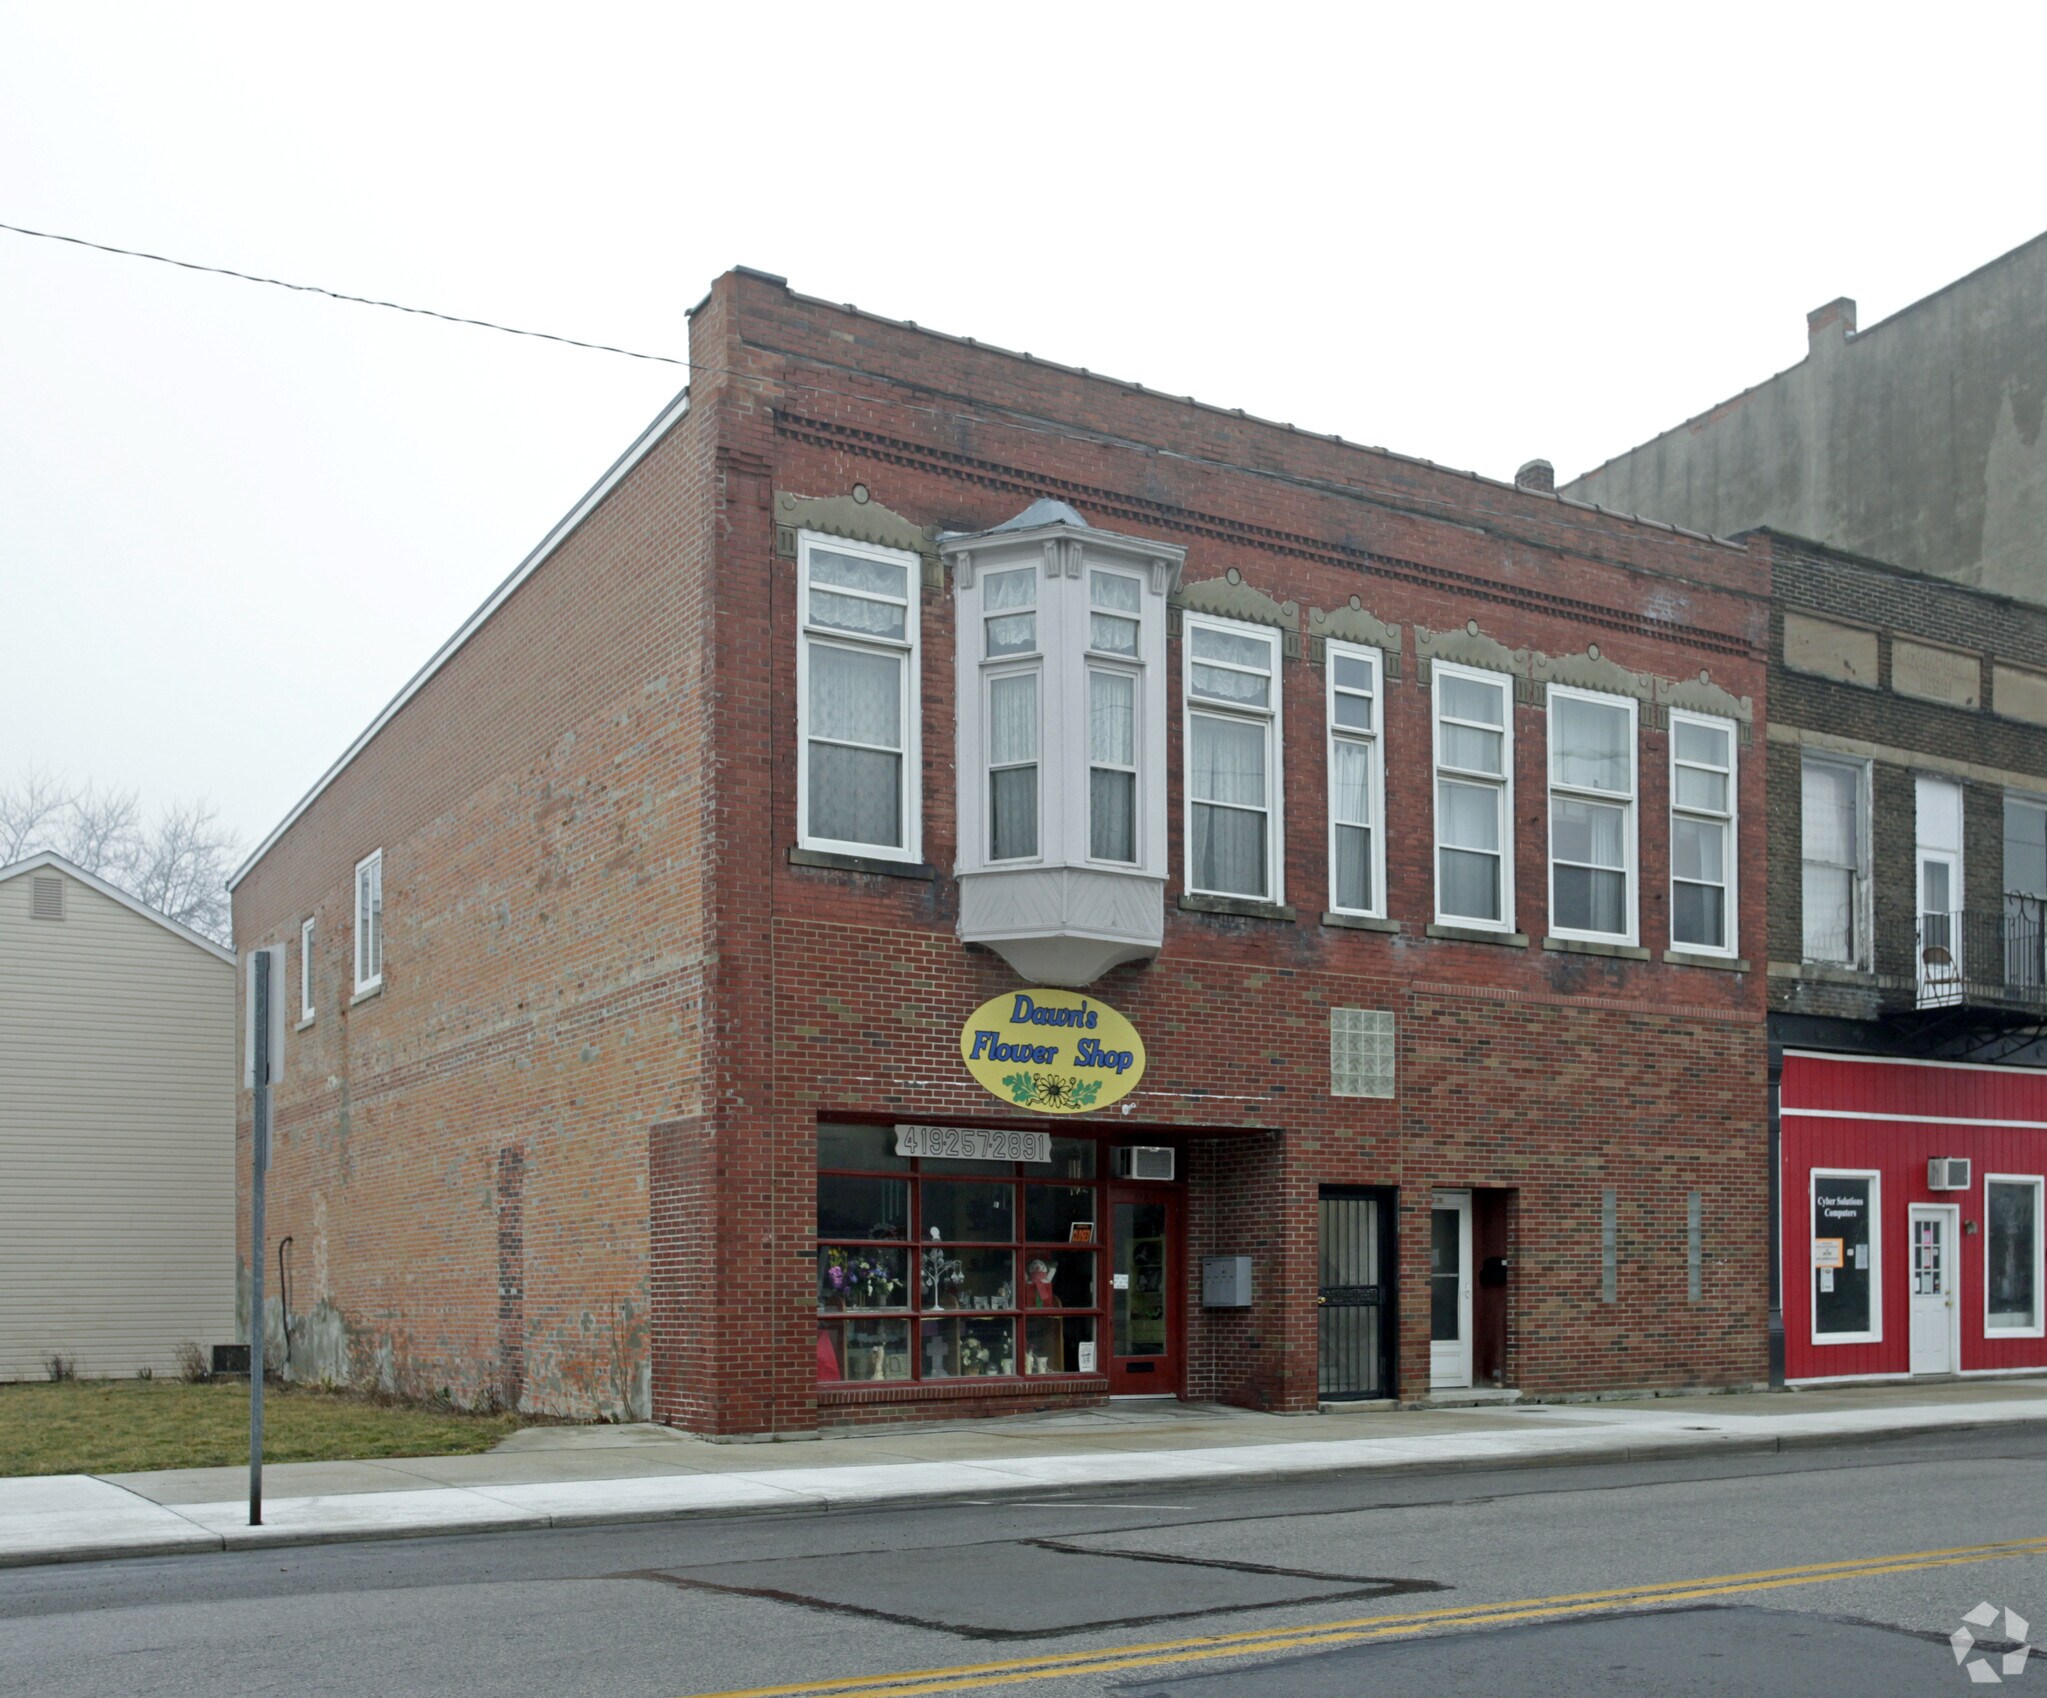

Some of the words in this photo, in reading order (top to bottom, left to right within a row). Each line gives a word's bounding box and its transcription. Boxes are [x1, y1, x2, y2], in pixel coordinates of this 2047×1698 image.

[1010, 994, 1098, 1029] Dawn's
[969, 1030, 1058, 1065] Flower
[1074, 1037, 1134, 1075] Shop
[1817, 1196, 1836, 1207] Cyber
[1836, 1196, 1864, 1206] Solutions
[1824, 1208, 1857, 1219] Computers
